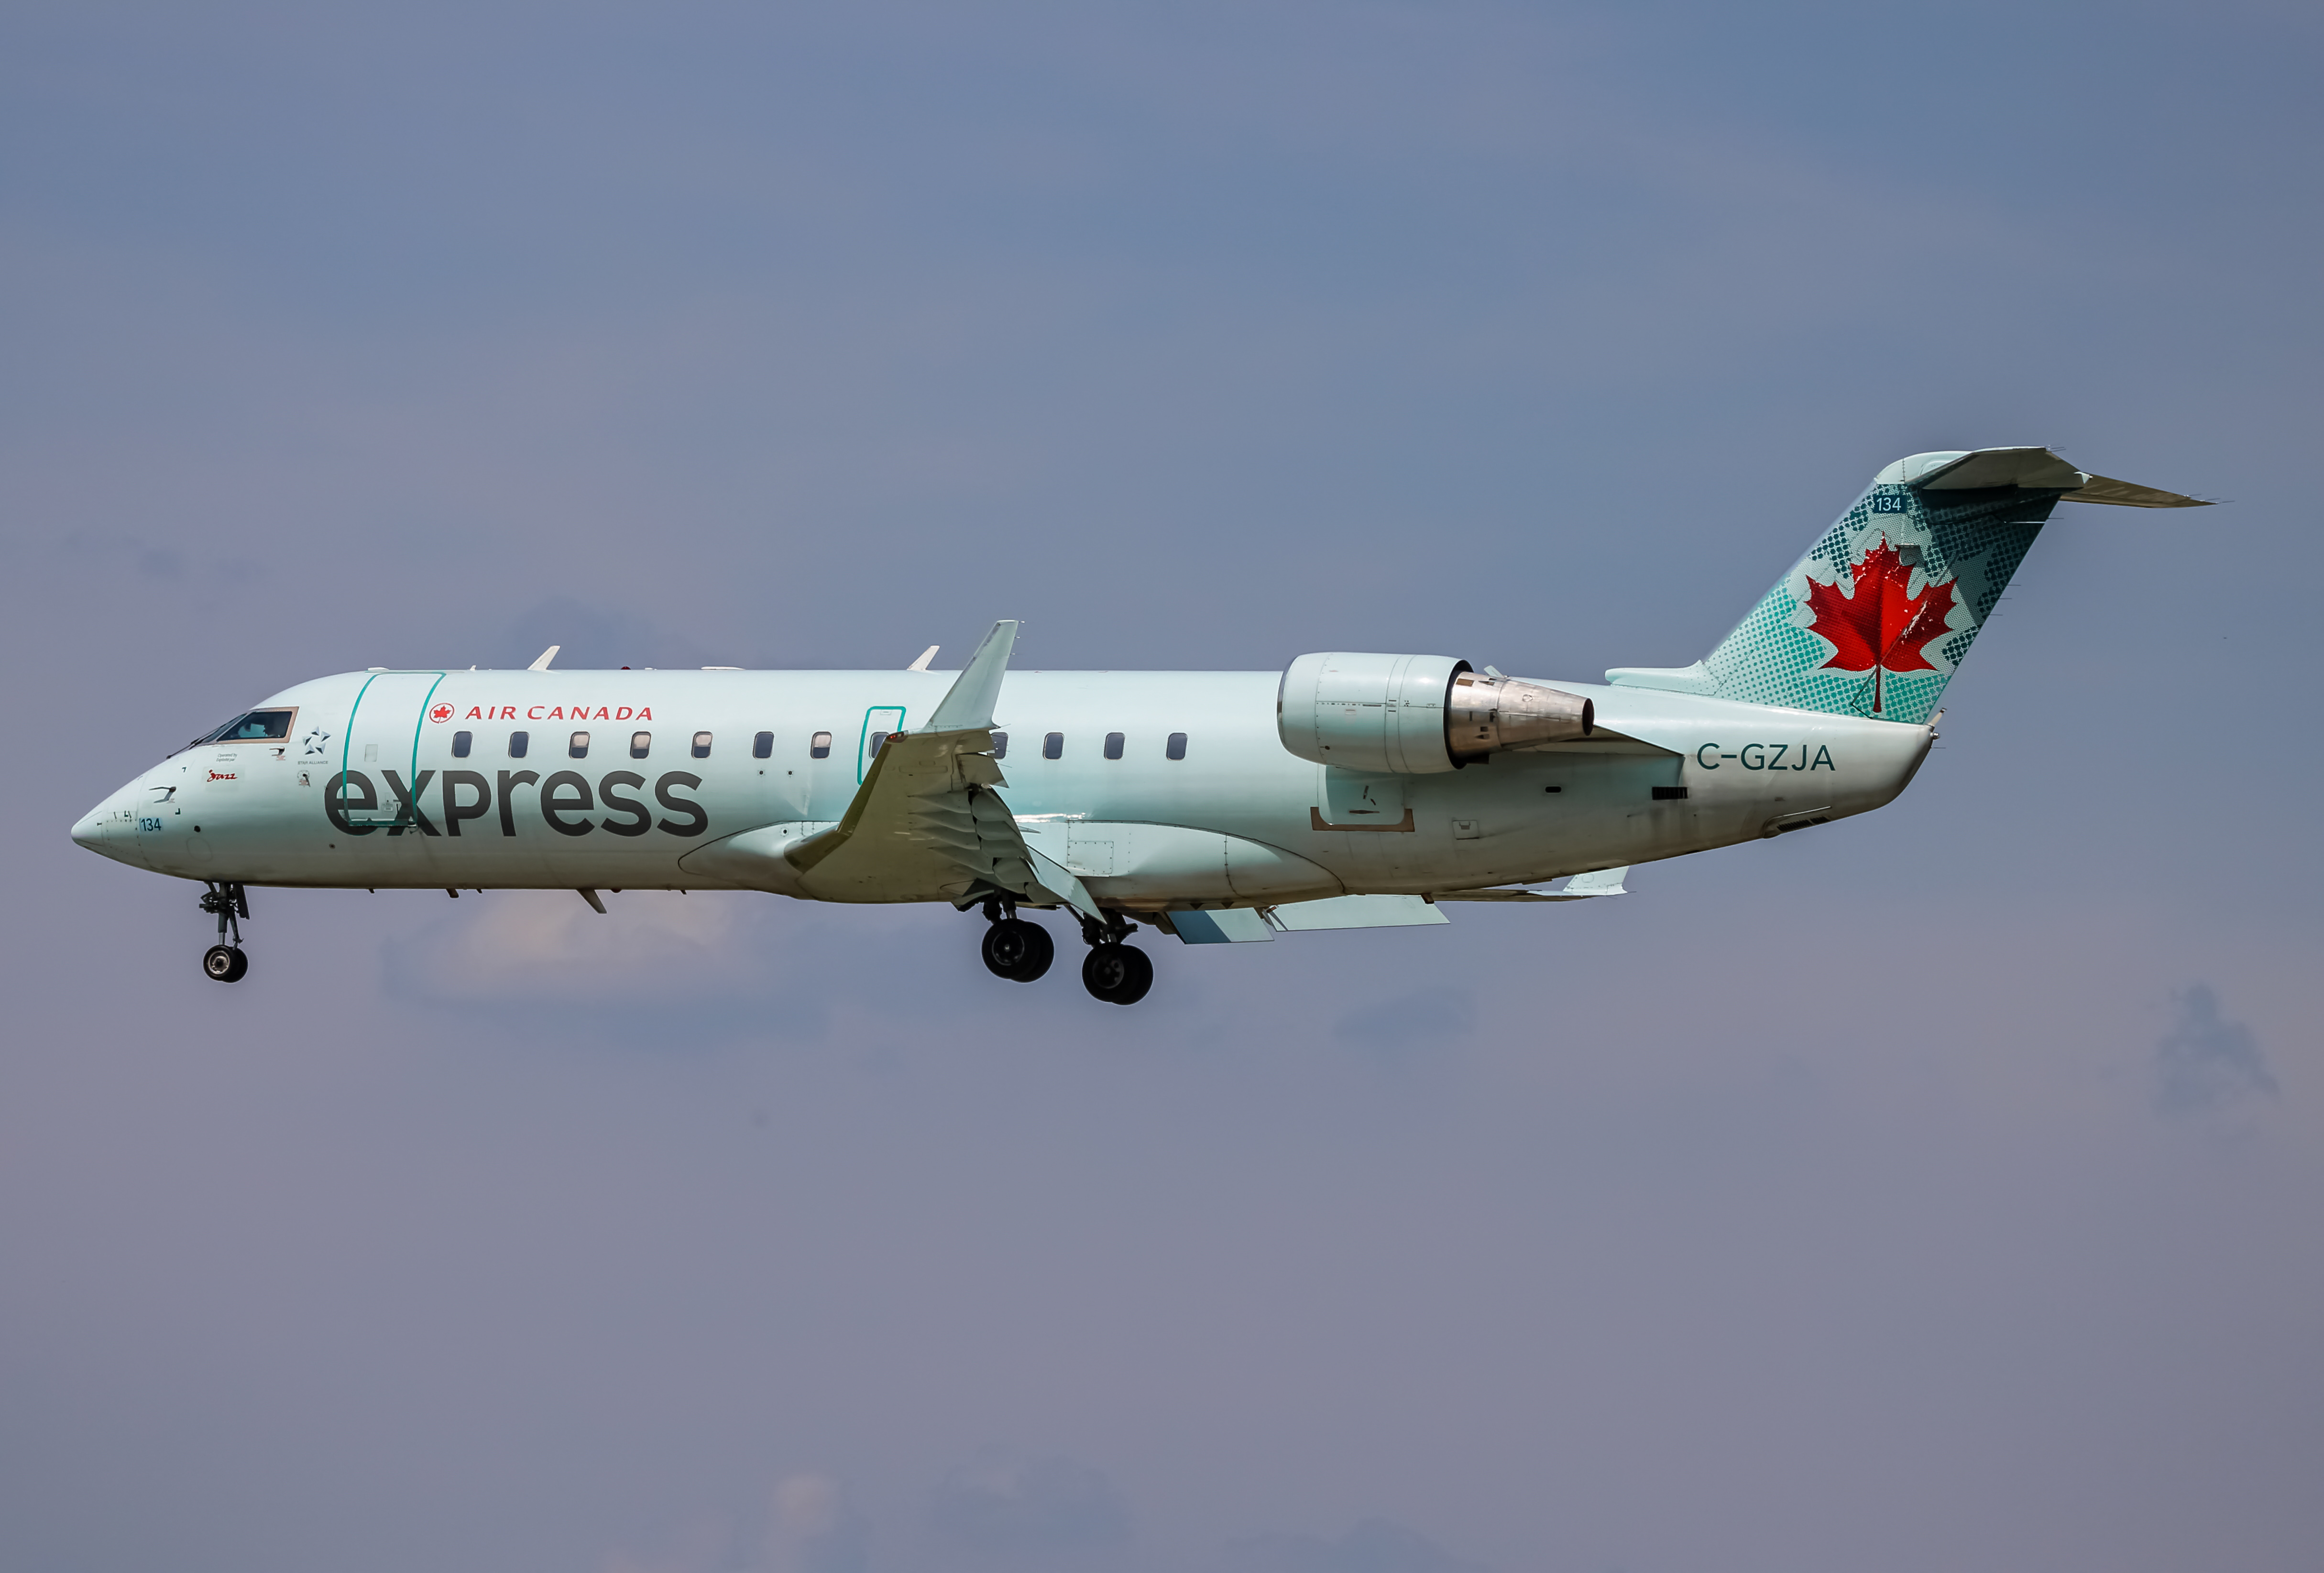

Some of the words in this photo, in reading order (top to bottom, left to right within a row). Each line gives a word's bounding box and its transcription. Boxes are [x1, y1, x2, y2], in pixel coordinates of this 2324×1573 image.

[1876, 497, 1901, 511] 134
[465, 706, 516, 720] AIR
[527, 705, 653, 721] CANADA
[1697, 743, 1836, 771] C-GZJA
[324, 770, 708, 837] express
[141, 818, 162, 832] 134
